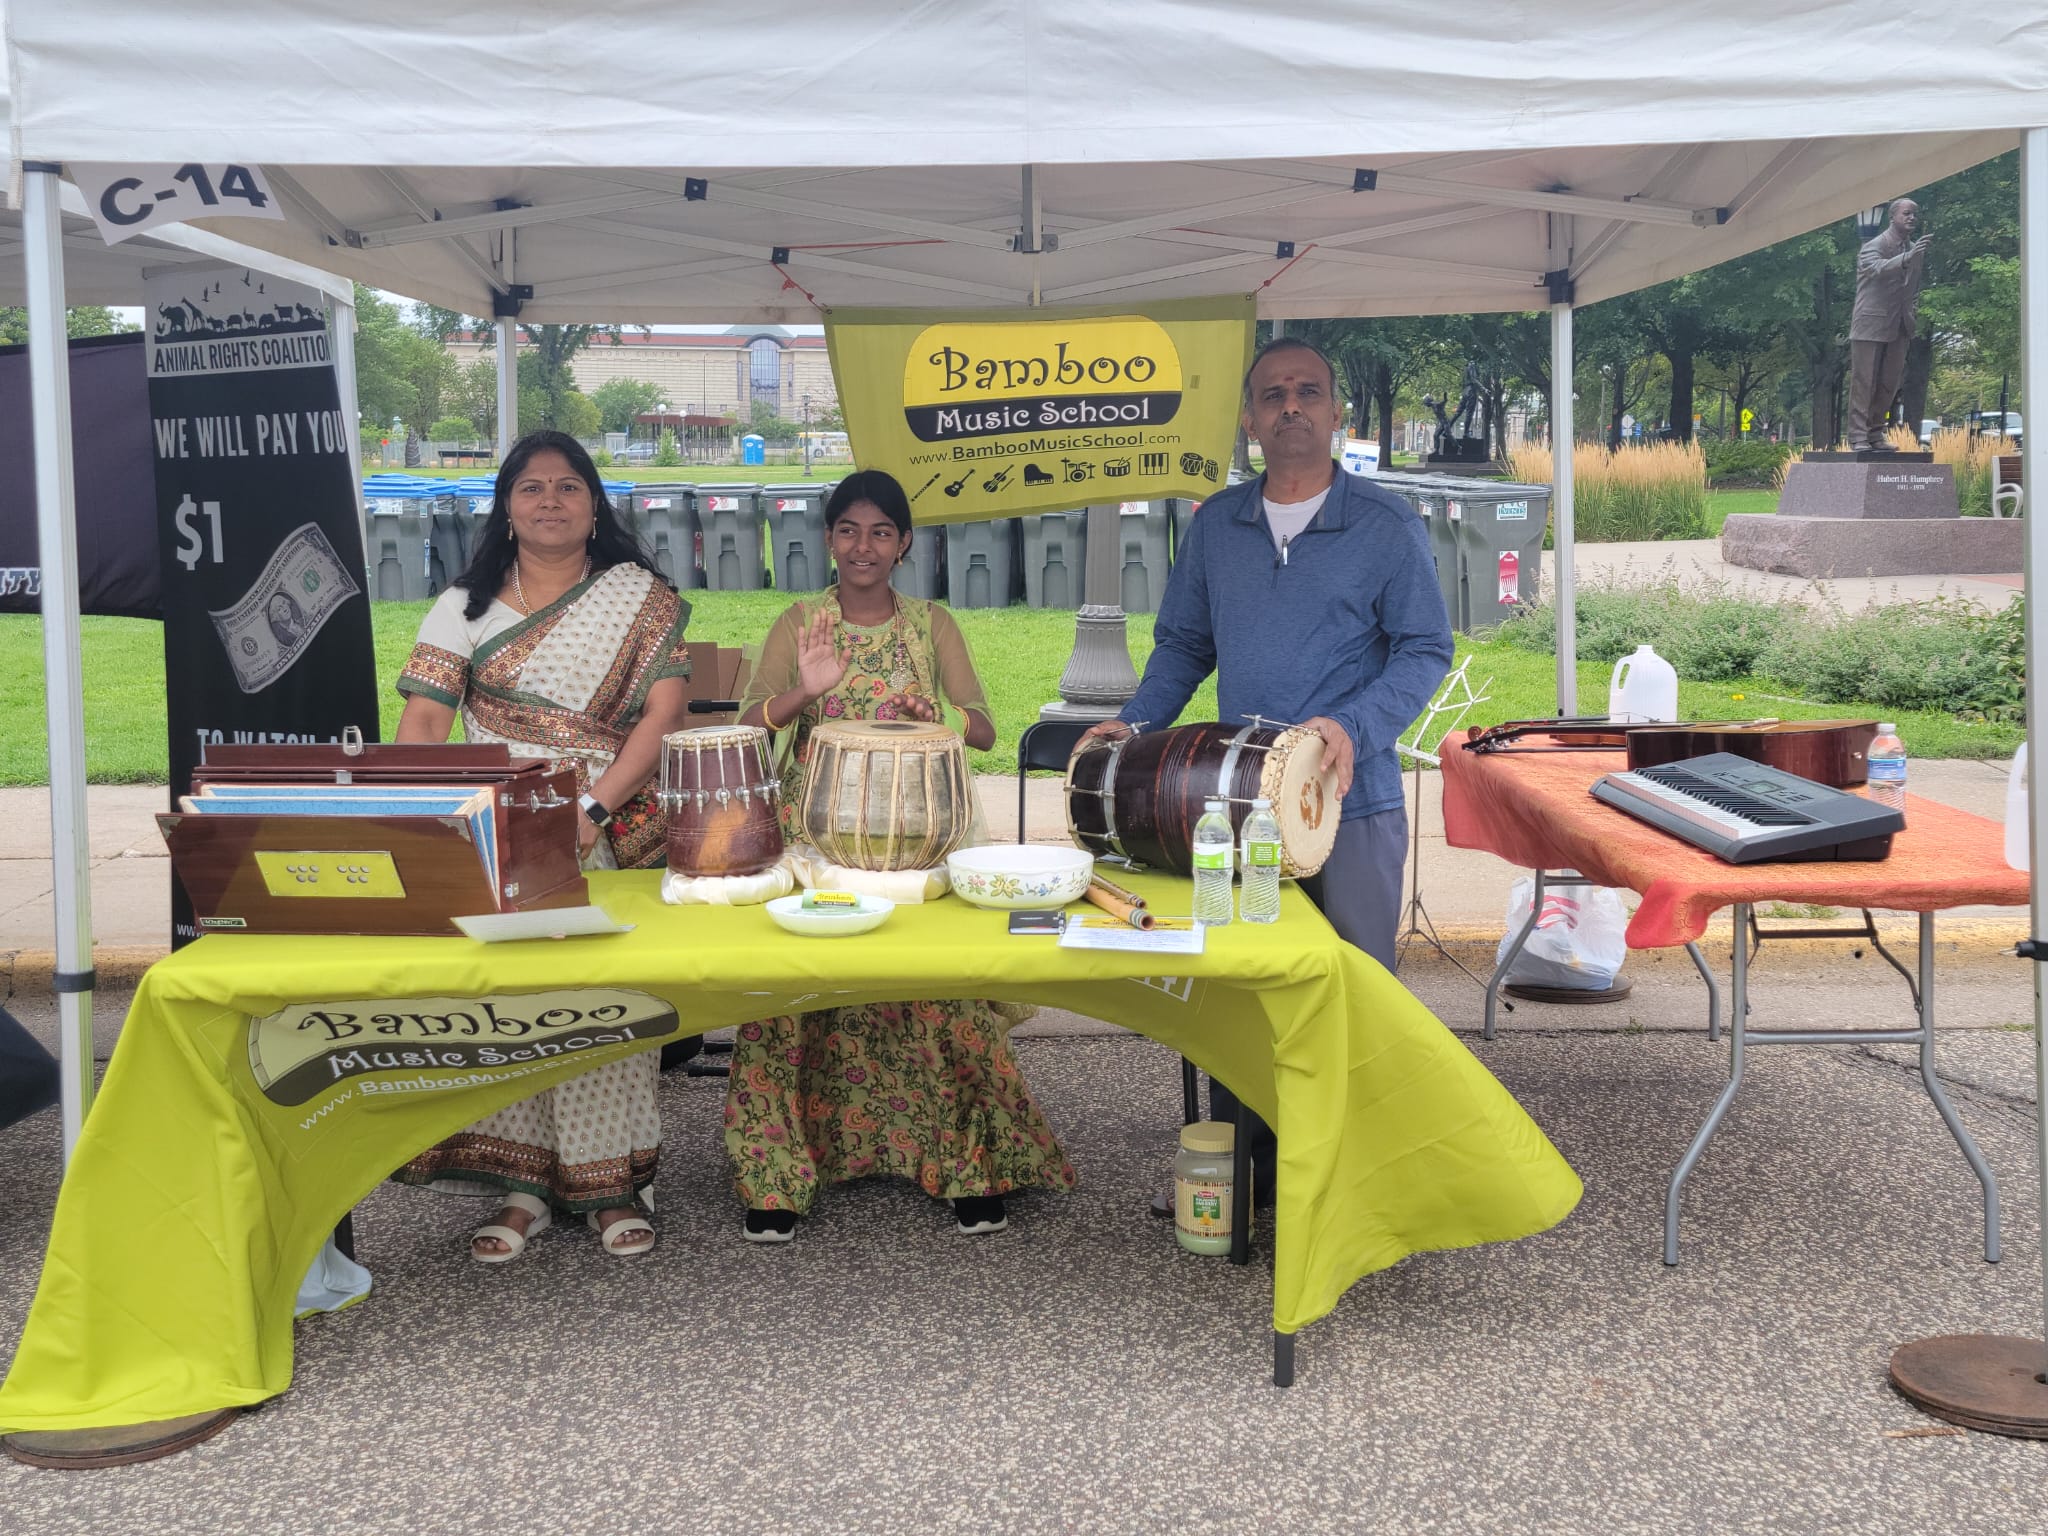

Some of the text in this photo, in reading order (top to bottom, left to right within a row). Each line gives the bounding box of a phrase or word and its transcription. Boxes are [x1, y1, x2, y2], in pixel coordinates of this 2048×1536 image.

[100, 163, 269, 225] C-14
[154, 345, 206, 373] ANIMAL
[209, 341, 260, 369] RIGHTS
[929, 342, 1157, 392] Bamboo
[154, 410, 347, 458] WE WILL PAY YOU
[935, 398, 1150, 435] Music School
[908, 431, 1181, 465] www.BambooMusicSchool.com
[175, 493, 224, 571] $1
[297, 1002, 628, 1041] Bamboo
[329, 1027, 636, 1079] Music School
